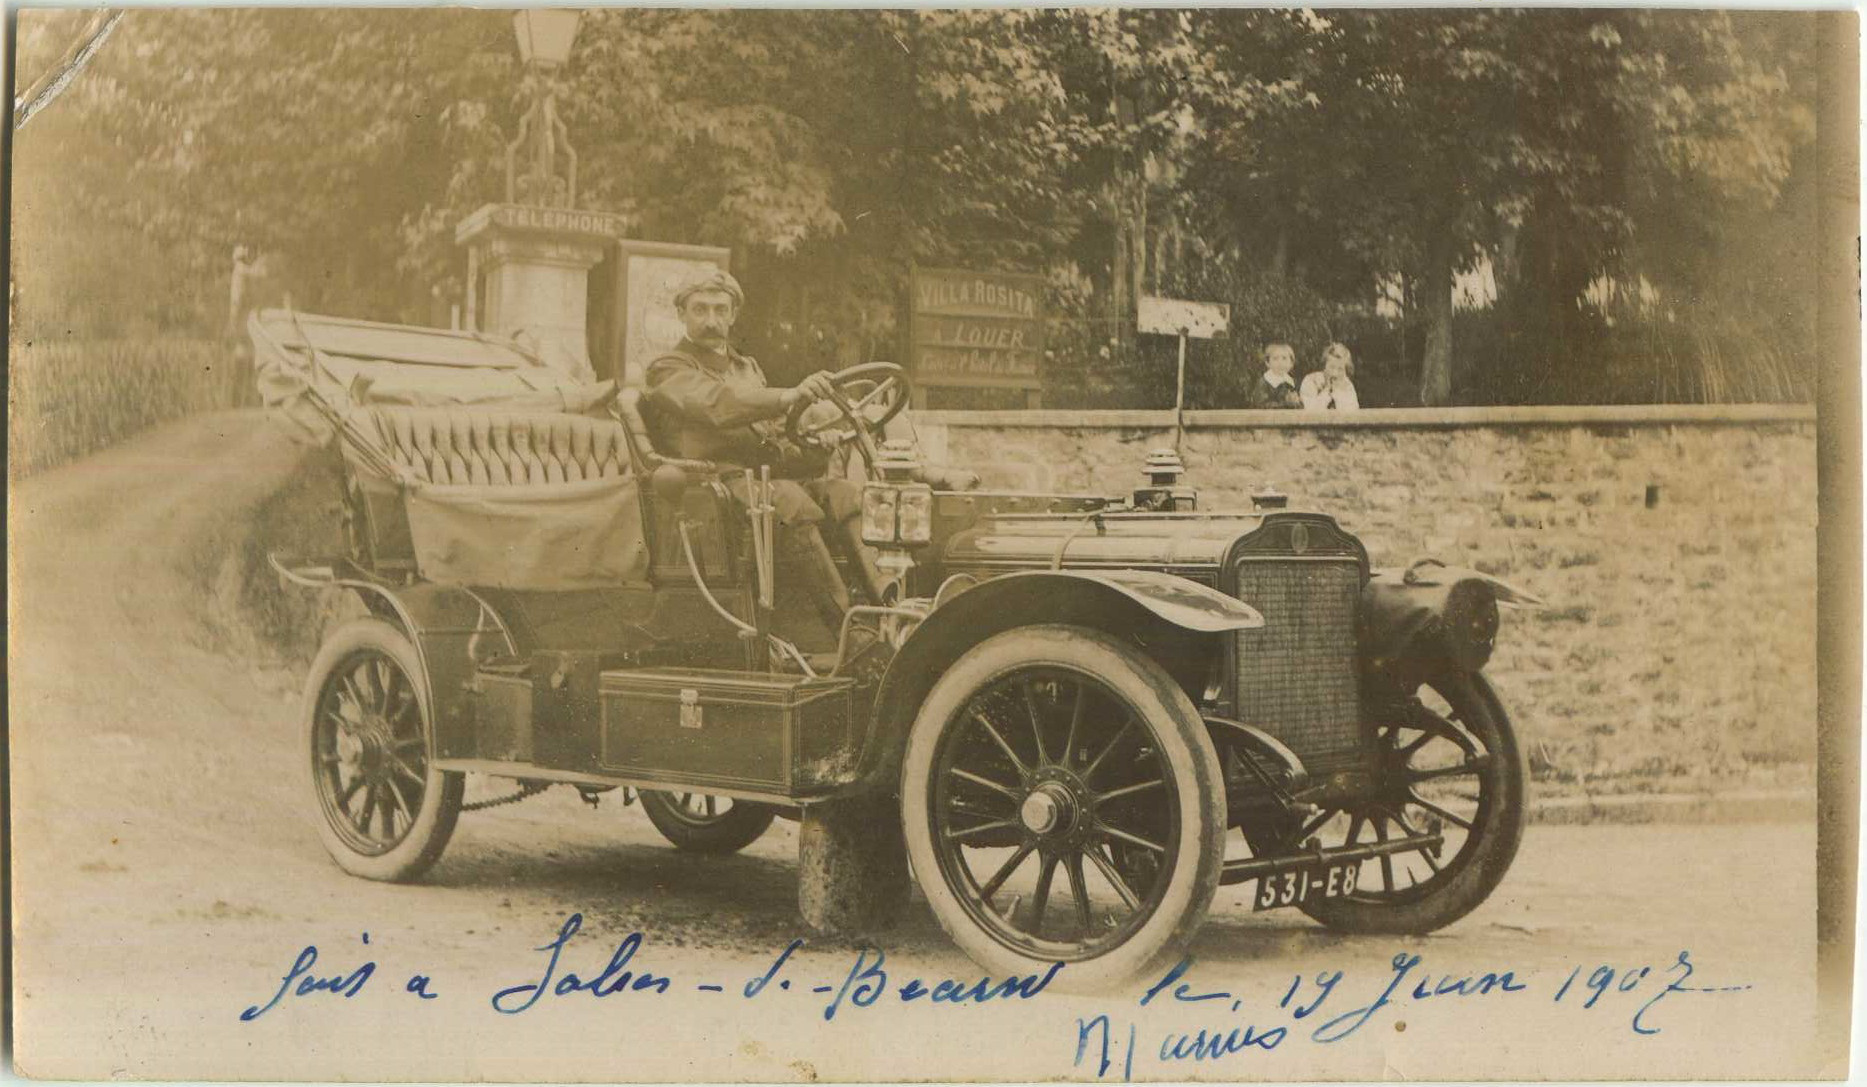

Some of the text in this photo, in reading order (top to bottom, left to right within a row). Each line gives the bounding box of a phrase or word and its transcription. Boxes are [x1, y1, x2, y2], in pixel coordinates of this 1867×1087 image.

[503, 208, 616, 236] TELEPHONE
[919, 279, 1035, 319] VILLA ROSITA
[954, 321, 1024, 349] LOUER
[1261, 865, 1356, 907] 531-E8
